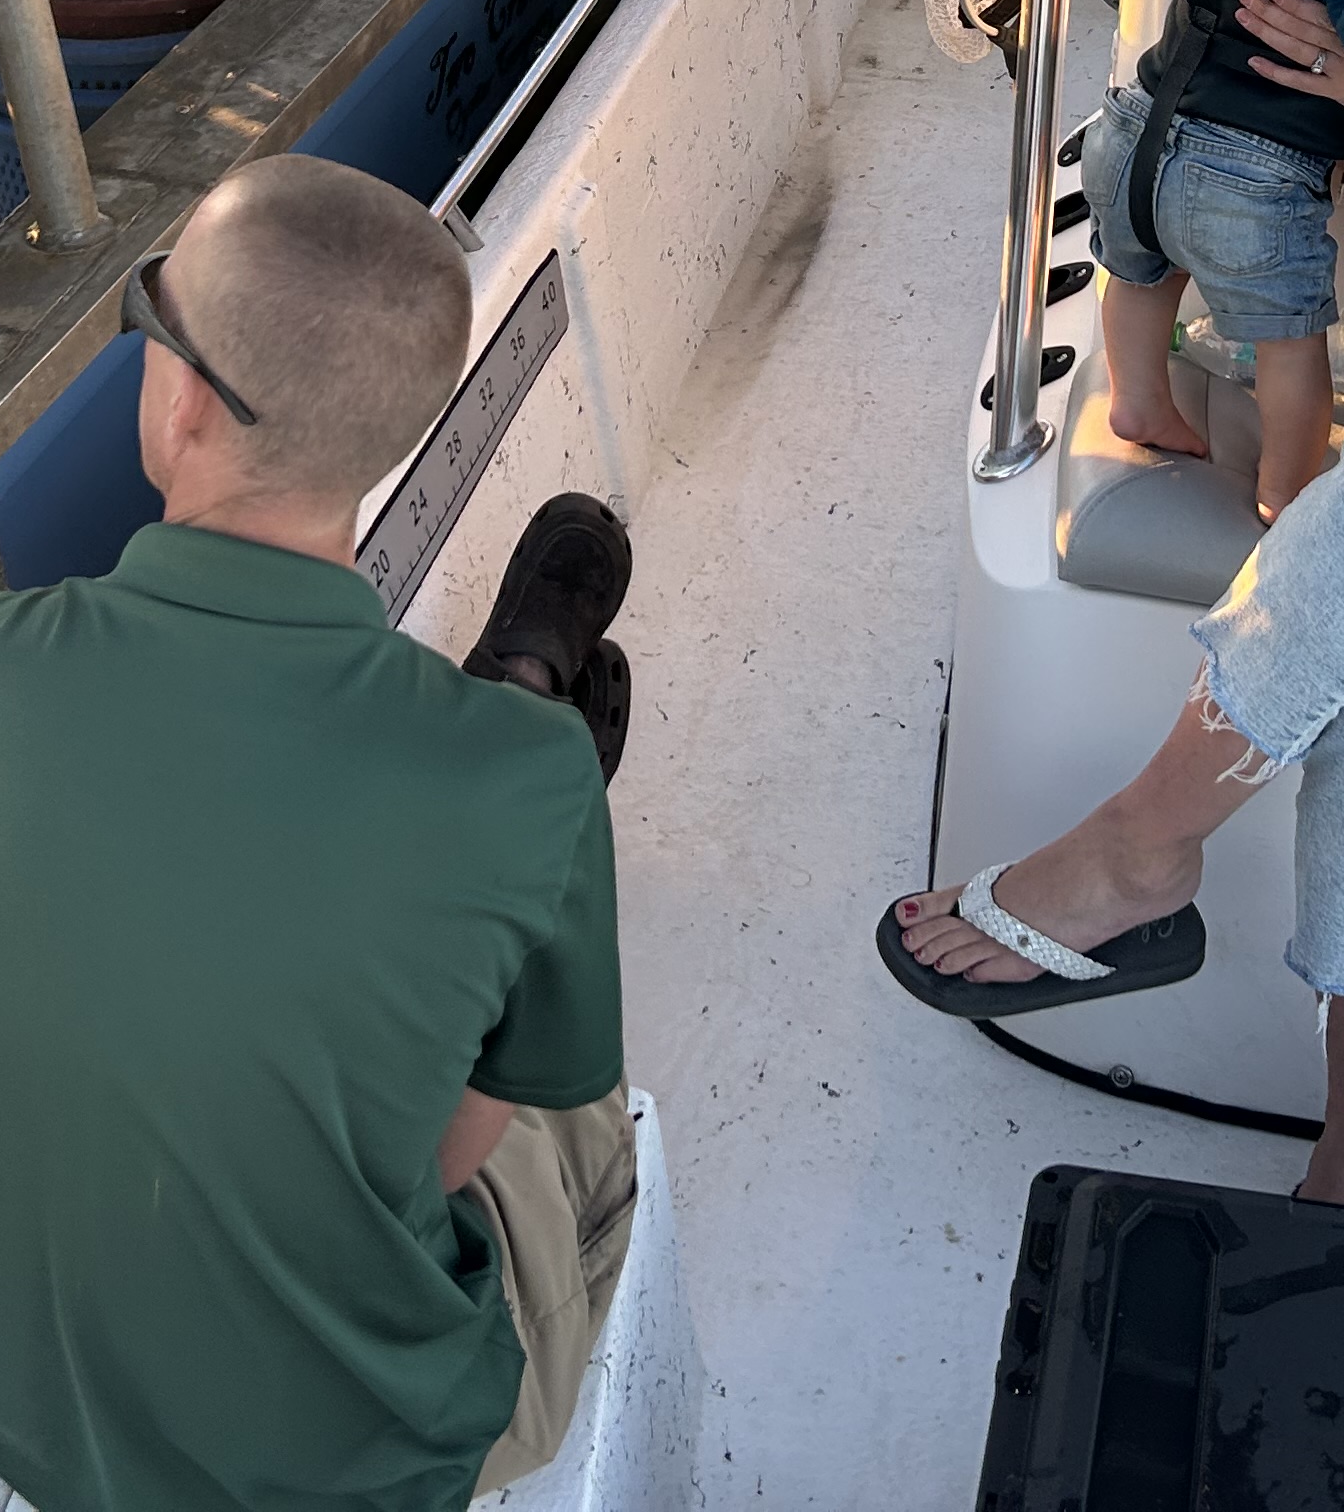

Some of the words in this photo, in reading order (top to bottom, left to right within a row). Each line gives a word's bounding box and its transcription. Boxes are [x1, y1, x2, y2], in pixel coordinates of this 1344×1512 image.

[370, 548, 391, 588] 20
[409, 487, 428, 527] 24
[445, 430, 463, 467] 28
[479, 376, 494, 411] 32
[509, 327, 526, 361] 36
[540, 280, 556, 313] 40
